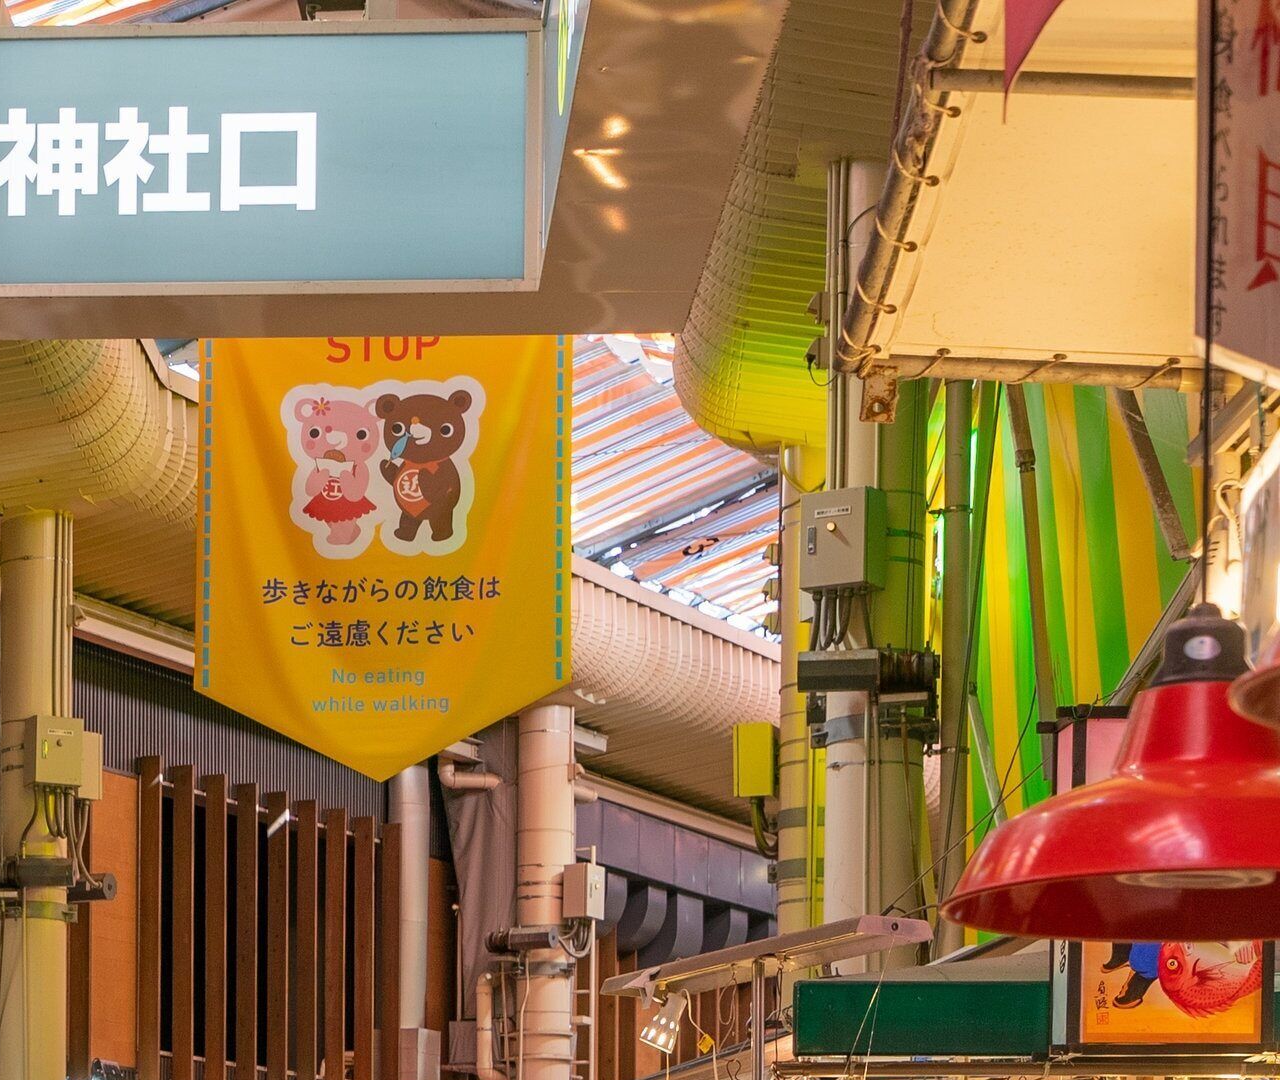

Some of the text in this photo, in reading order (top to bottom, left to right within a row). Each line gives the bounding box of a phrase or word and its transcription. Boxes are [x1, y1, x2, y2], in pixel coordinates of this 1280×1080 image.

[326, 336, 441, 363] STOP
[262, 575, 501, 605] 歩きながらの飲食は
[290, 619, 474, 648] ご遠慮ください
[331, 667, 426, 687] No eating
[312, 694, 450, 714] while walking
